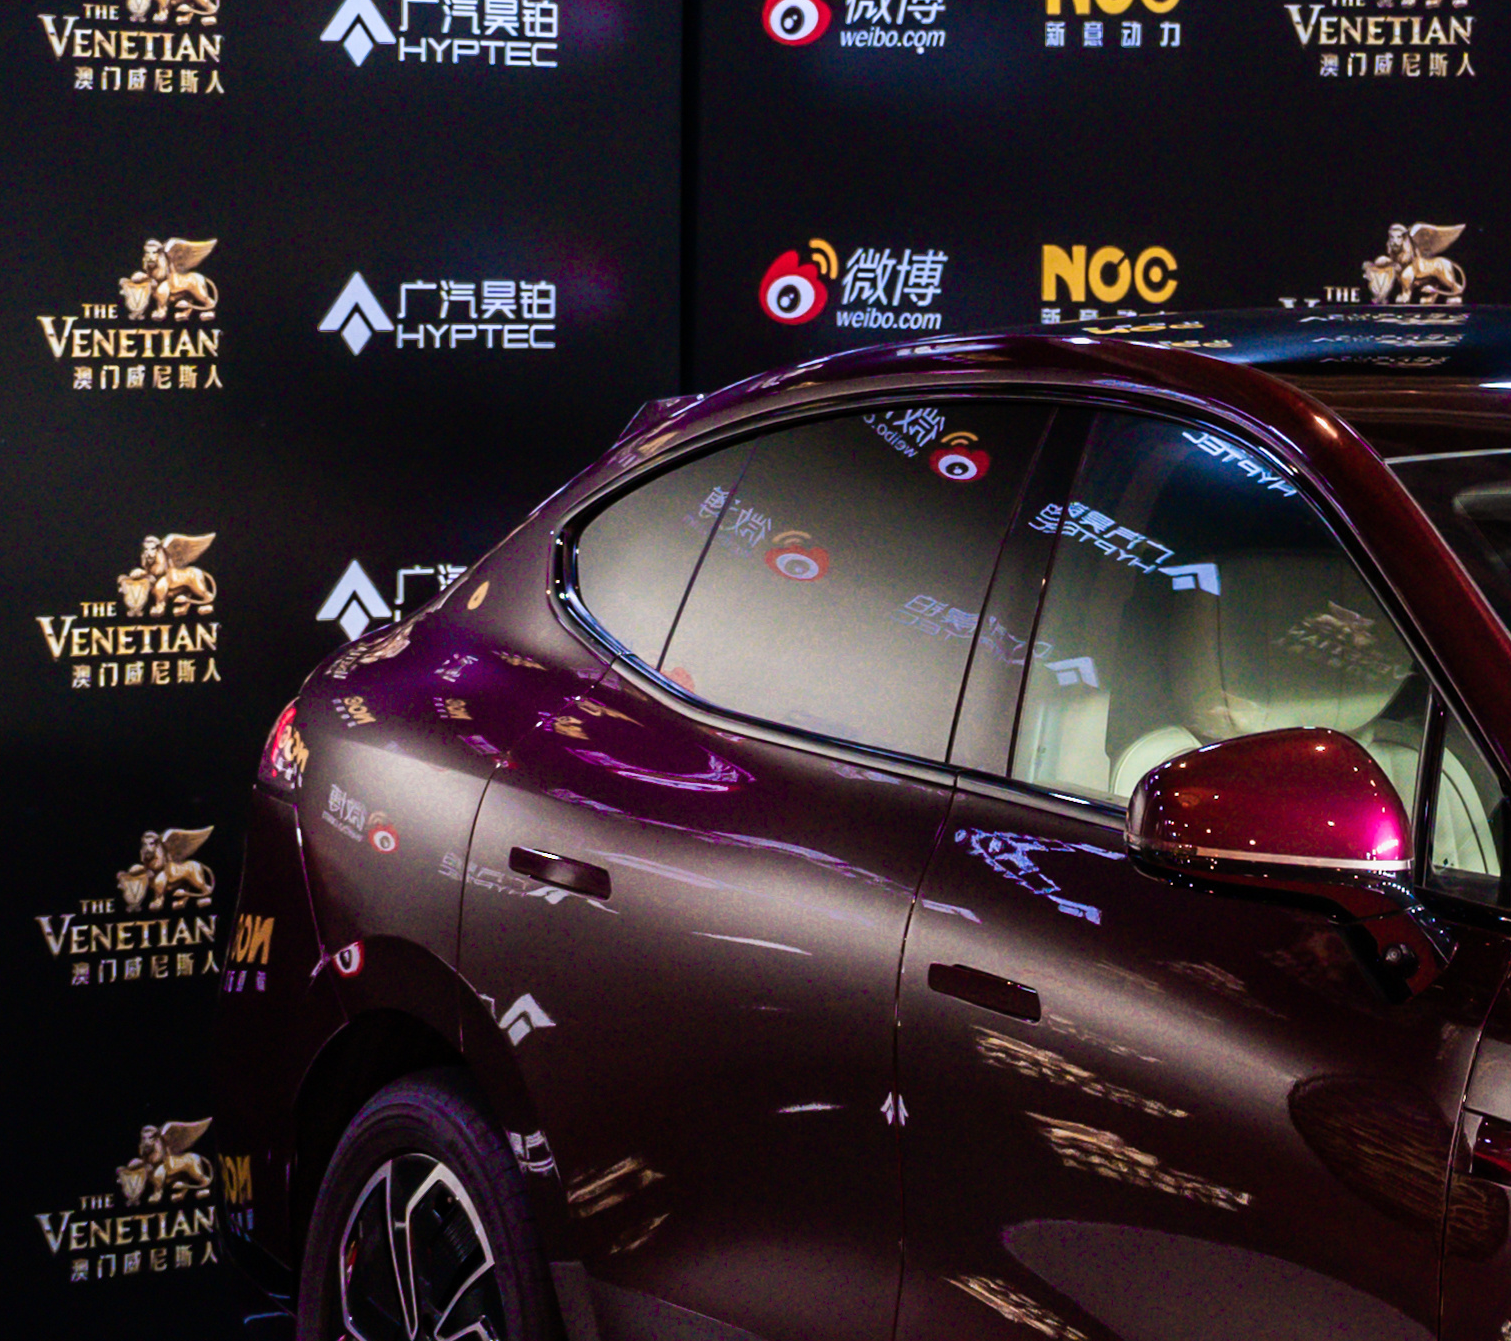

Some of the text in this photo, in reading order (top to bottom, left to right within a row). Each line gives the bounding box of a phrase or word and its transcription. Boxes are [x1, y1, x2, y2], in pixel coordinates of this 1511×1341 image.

[37, 13, 223, 63] VENETIAN
[839, 25, 947, 50] weibo.com
[1283, 3, 1474, 46] VENETIAN
[36, 315, 221, 359] VENETIAN
[835, 307, 943, 331] weibo.com
[35, 615, 219, 659] VENETIAN
[35, 913, 218, 956] VENETIAN
